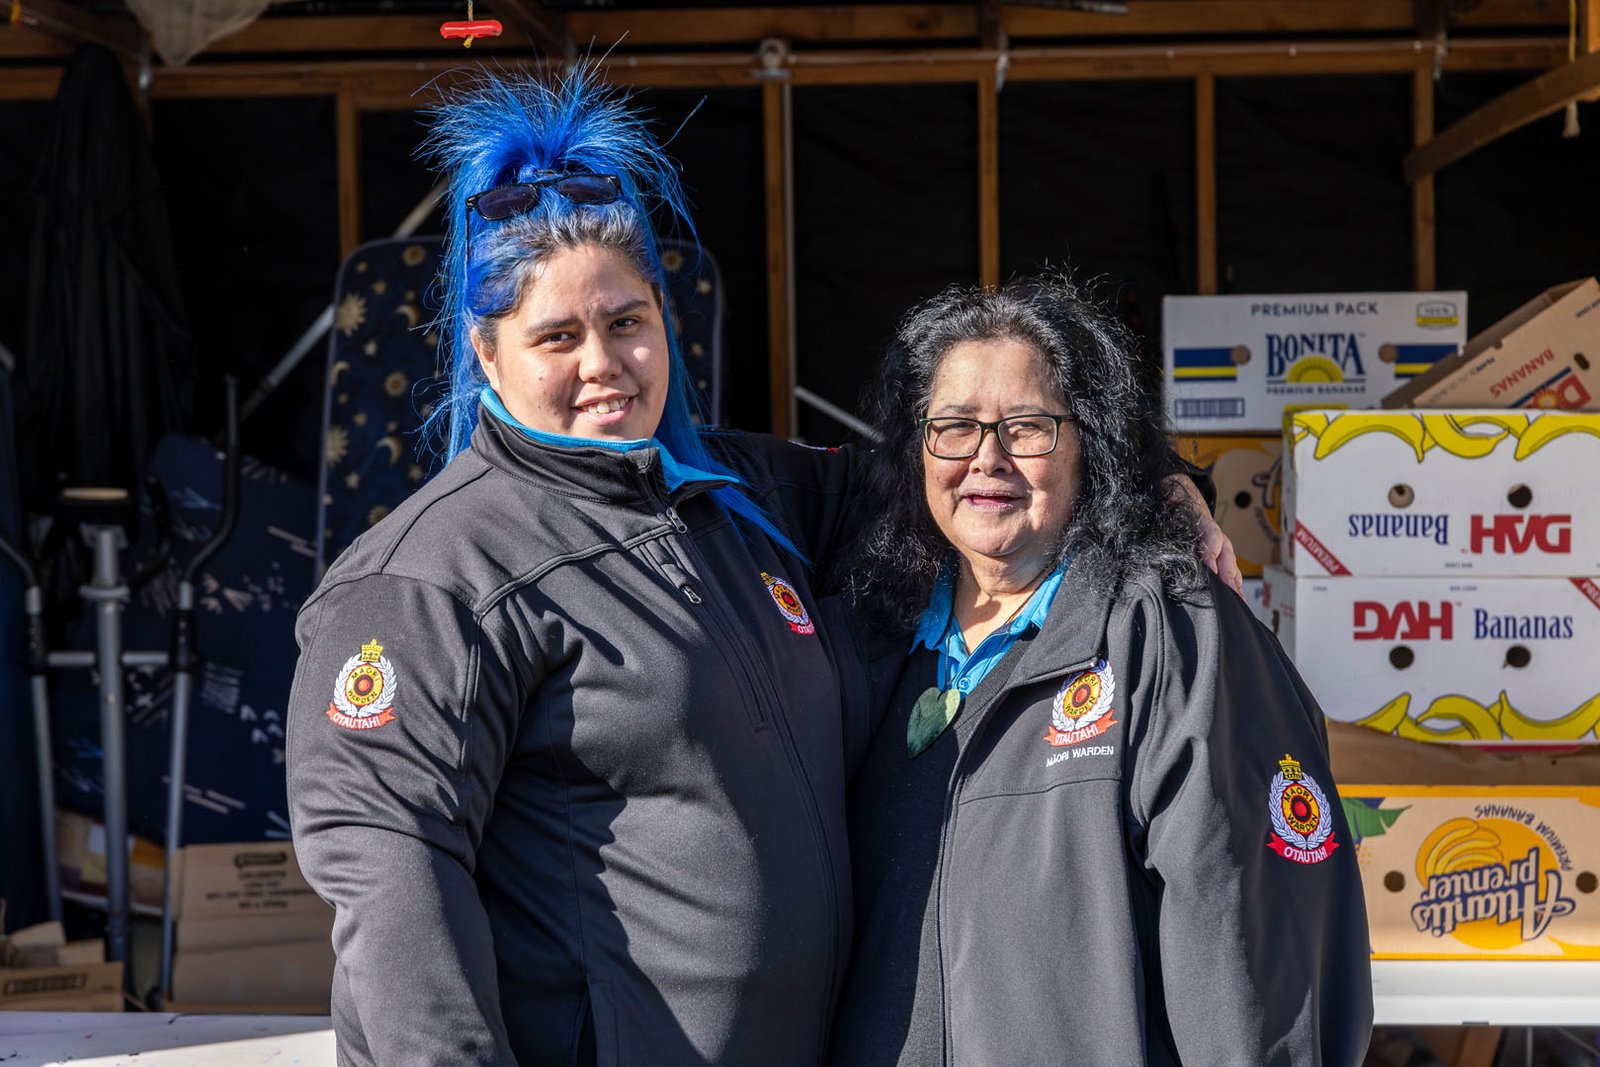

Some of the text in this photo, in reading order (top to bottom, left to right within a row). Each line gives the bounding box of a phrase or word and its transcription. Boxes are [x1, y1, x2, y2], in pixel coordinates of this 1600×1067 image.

[1251, 302, 1379, 316] PREMIUM PACK
[1265, 333, 1365, 378] BONITA
[1489, 348, 1555, 398] BANANAS
[1266, 386, 1366, 395] PREMIUM BANANAS
[1348, 514, 1449, 545] Bananas
[1297, 527, 1341, 575] PREMIUM
[1353, 601, 1574, 641] DAH Bananas
[351, 667, 381, 682] MAORI
[332, 712, 381, 729] OTAUTAHI
[1055, 724, 1100, 744] OTAUTAHI
[1072, 746, 1114, 759] WARDEN
[1283, 787, 1313, 802] MAORI
[1287, 813, 1319, 832] WARDEN
[1475, 804, 1574, 871] PREMIUM BANANAS
[1283, 846, 1328, 863] OTAUTAHI
[1421, 846, 1540, 901] premier
[1411, 870, 1576, 941] Atlantis
